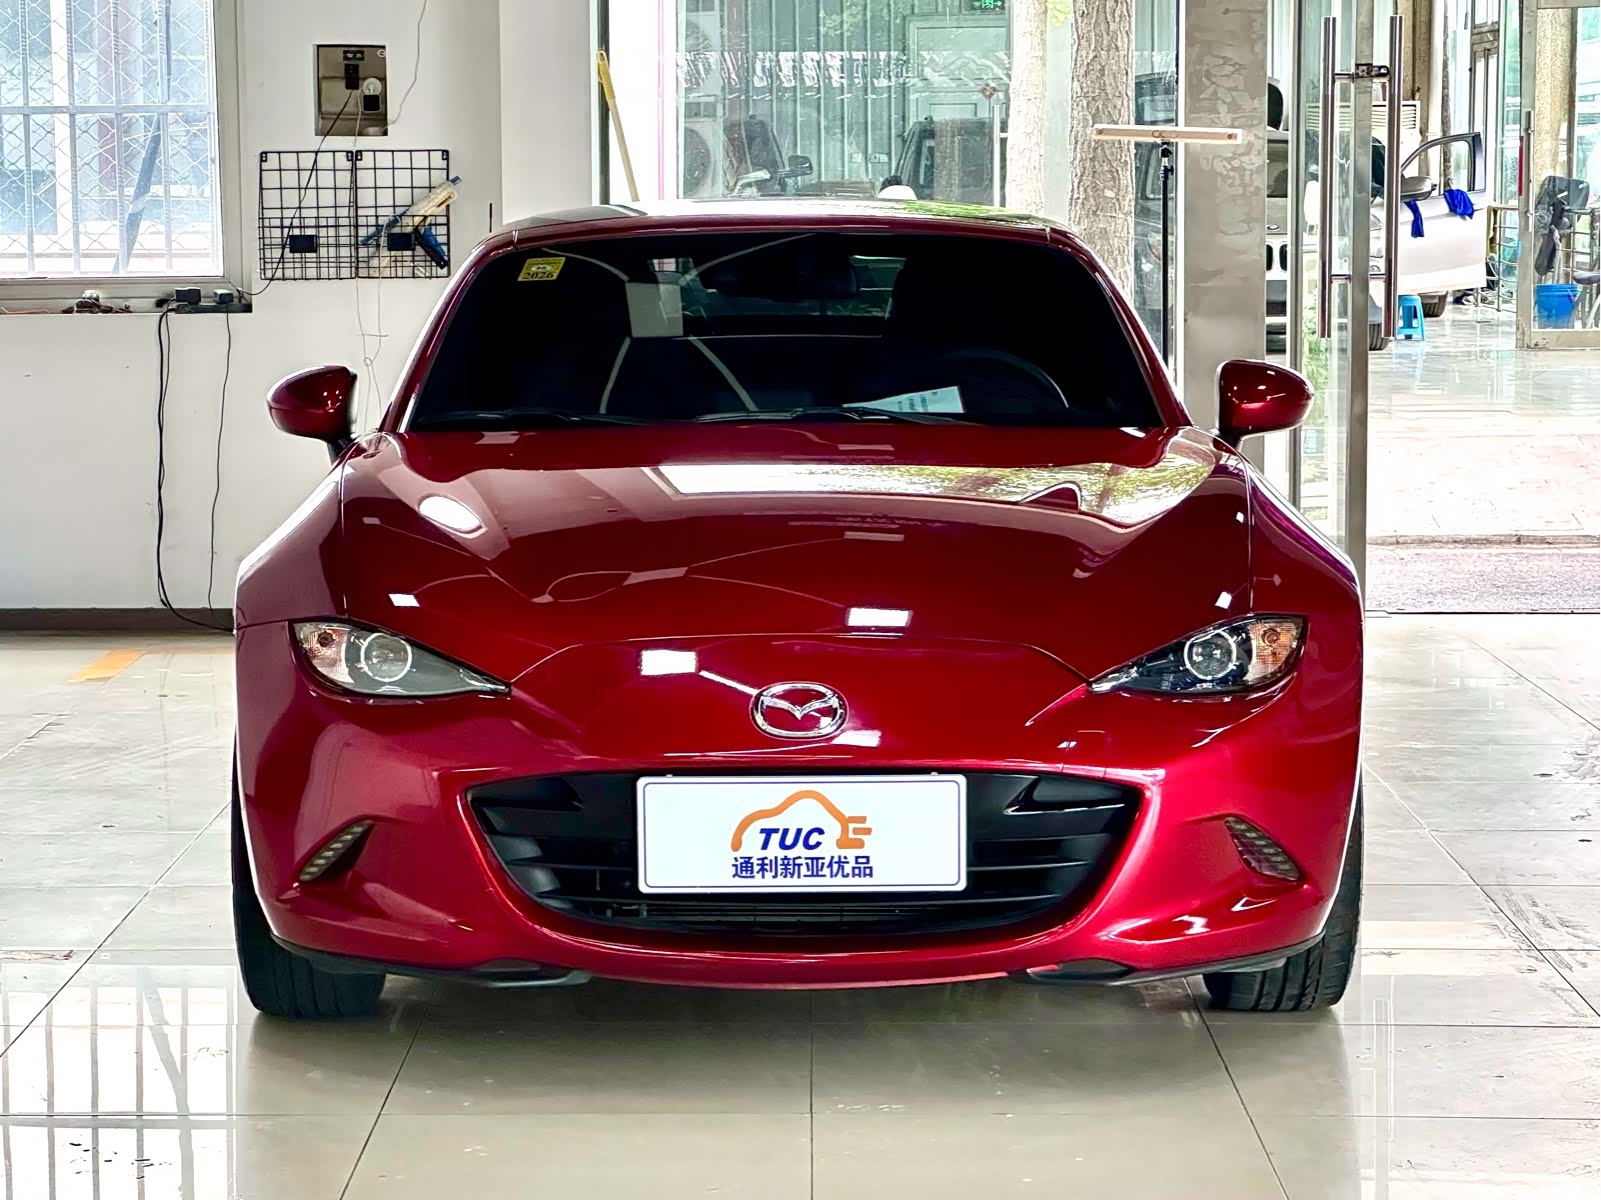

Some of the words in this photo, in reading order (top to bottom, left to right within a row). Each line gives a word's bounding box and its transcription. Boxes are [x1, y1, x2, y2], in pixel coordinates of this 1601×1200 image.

[521, 270, 555, 280] 2026
[759, 827, 825, 851] TUC
[731, 855, 874, 879] 通利新亚优品
